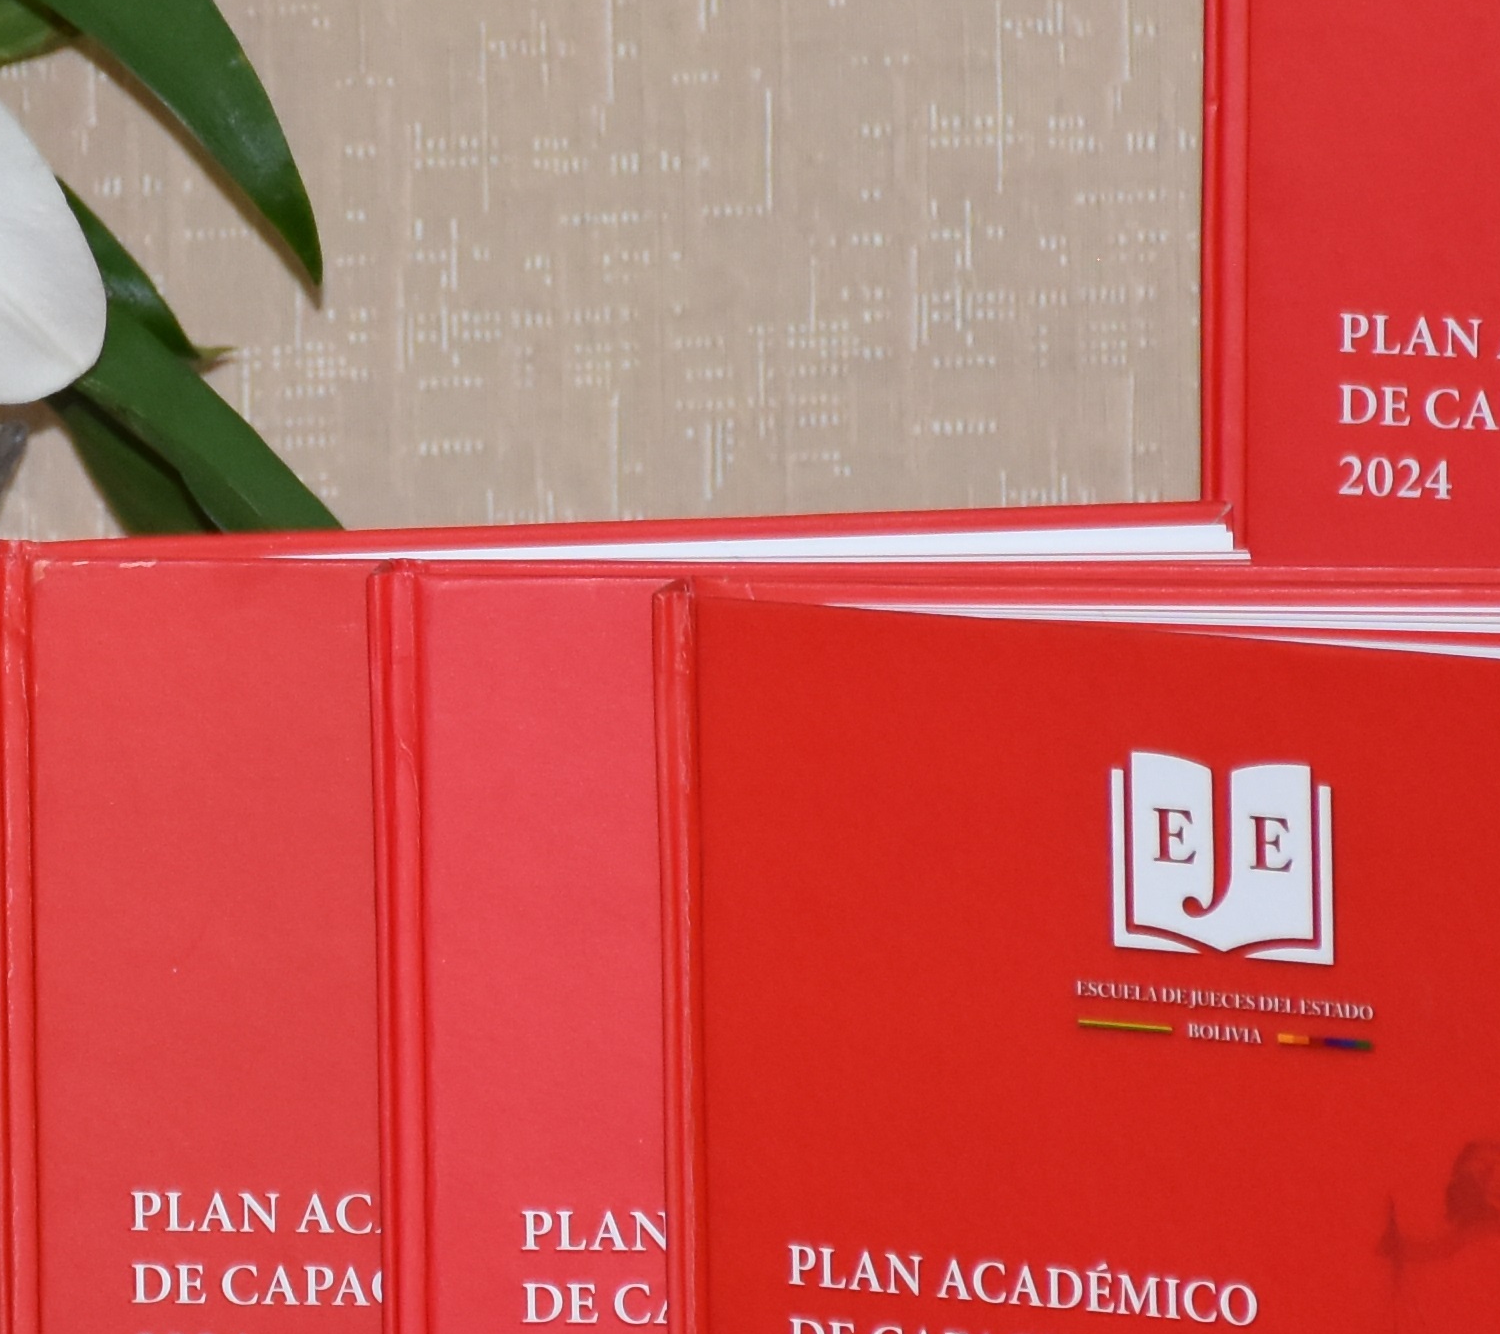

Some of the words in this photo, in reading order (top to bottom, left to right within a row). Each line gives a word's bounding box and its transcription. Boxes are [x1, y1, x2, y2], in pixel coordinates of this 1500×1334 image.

[1339, 313, 1481, 359] PLAN
[1339, 384, 1411, 427] DE
[1338, 456, 1452, 500] 2024
[1076, 980, 1158, 1003] ESCUELA
[1162, 987, 1187, 1005] DE
[1188, 989, 1255, 1011] JUECES
[1259, 997, 1297, 1014] DEL
[1300, 1001, 1373, 1020] ESTADO
[1188, 1023, 1261, 1044] BOLIVIA
[130, 1191, 279, 1233] PLAN
[521, 1209, 666, 1252] PLAN
[131, 1264, 207, 1305] DE
[522, 1283, 599, 1325] DE
[788, 1244, 923, 1297] PLAN
[936, 1258, 1259, 1327] ACADÉMICO
